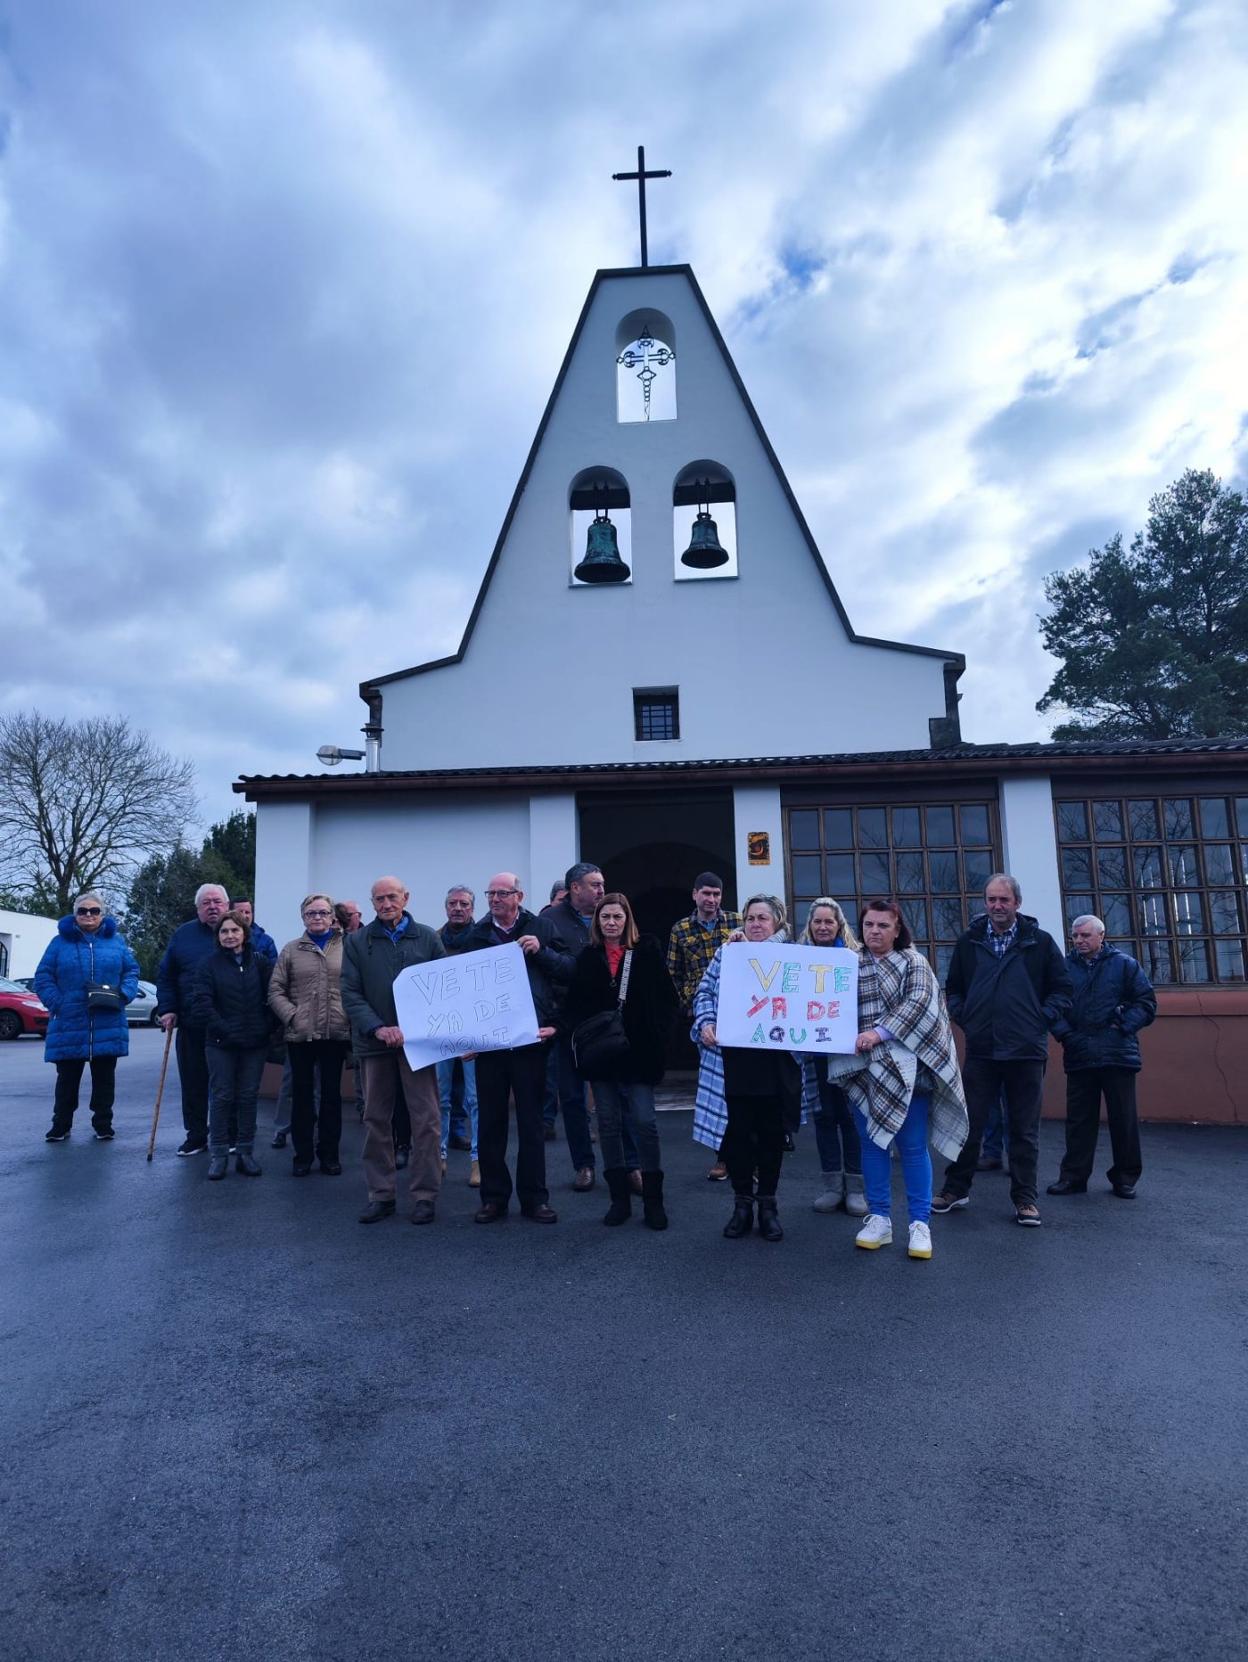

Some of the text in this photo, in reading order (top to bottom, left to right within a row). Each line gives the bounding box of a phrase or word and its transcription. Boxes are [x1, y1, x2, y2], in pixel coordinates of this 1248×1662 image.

[411, 957, 515, 1005] VETE
[748, 959, 853, 993] VETE
[427, 993, 512, 1038] YA DE
[746, 994, 840, 1021] YA DE
[751, 1023, 832, 1044] AQUI
